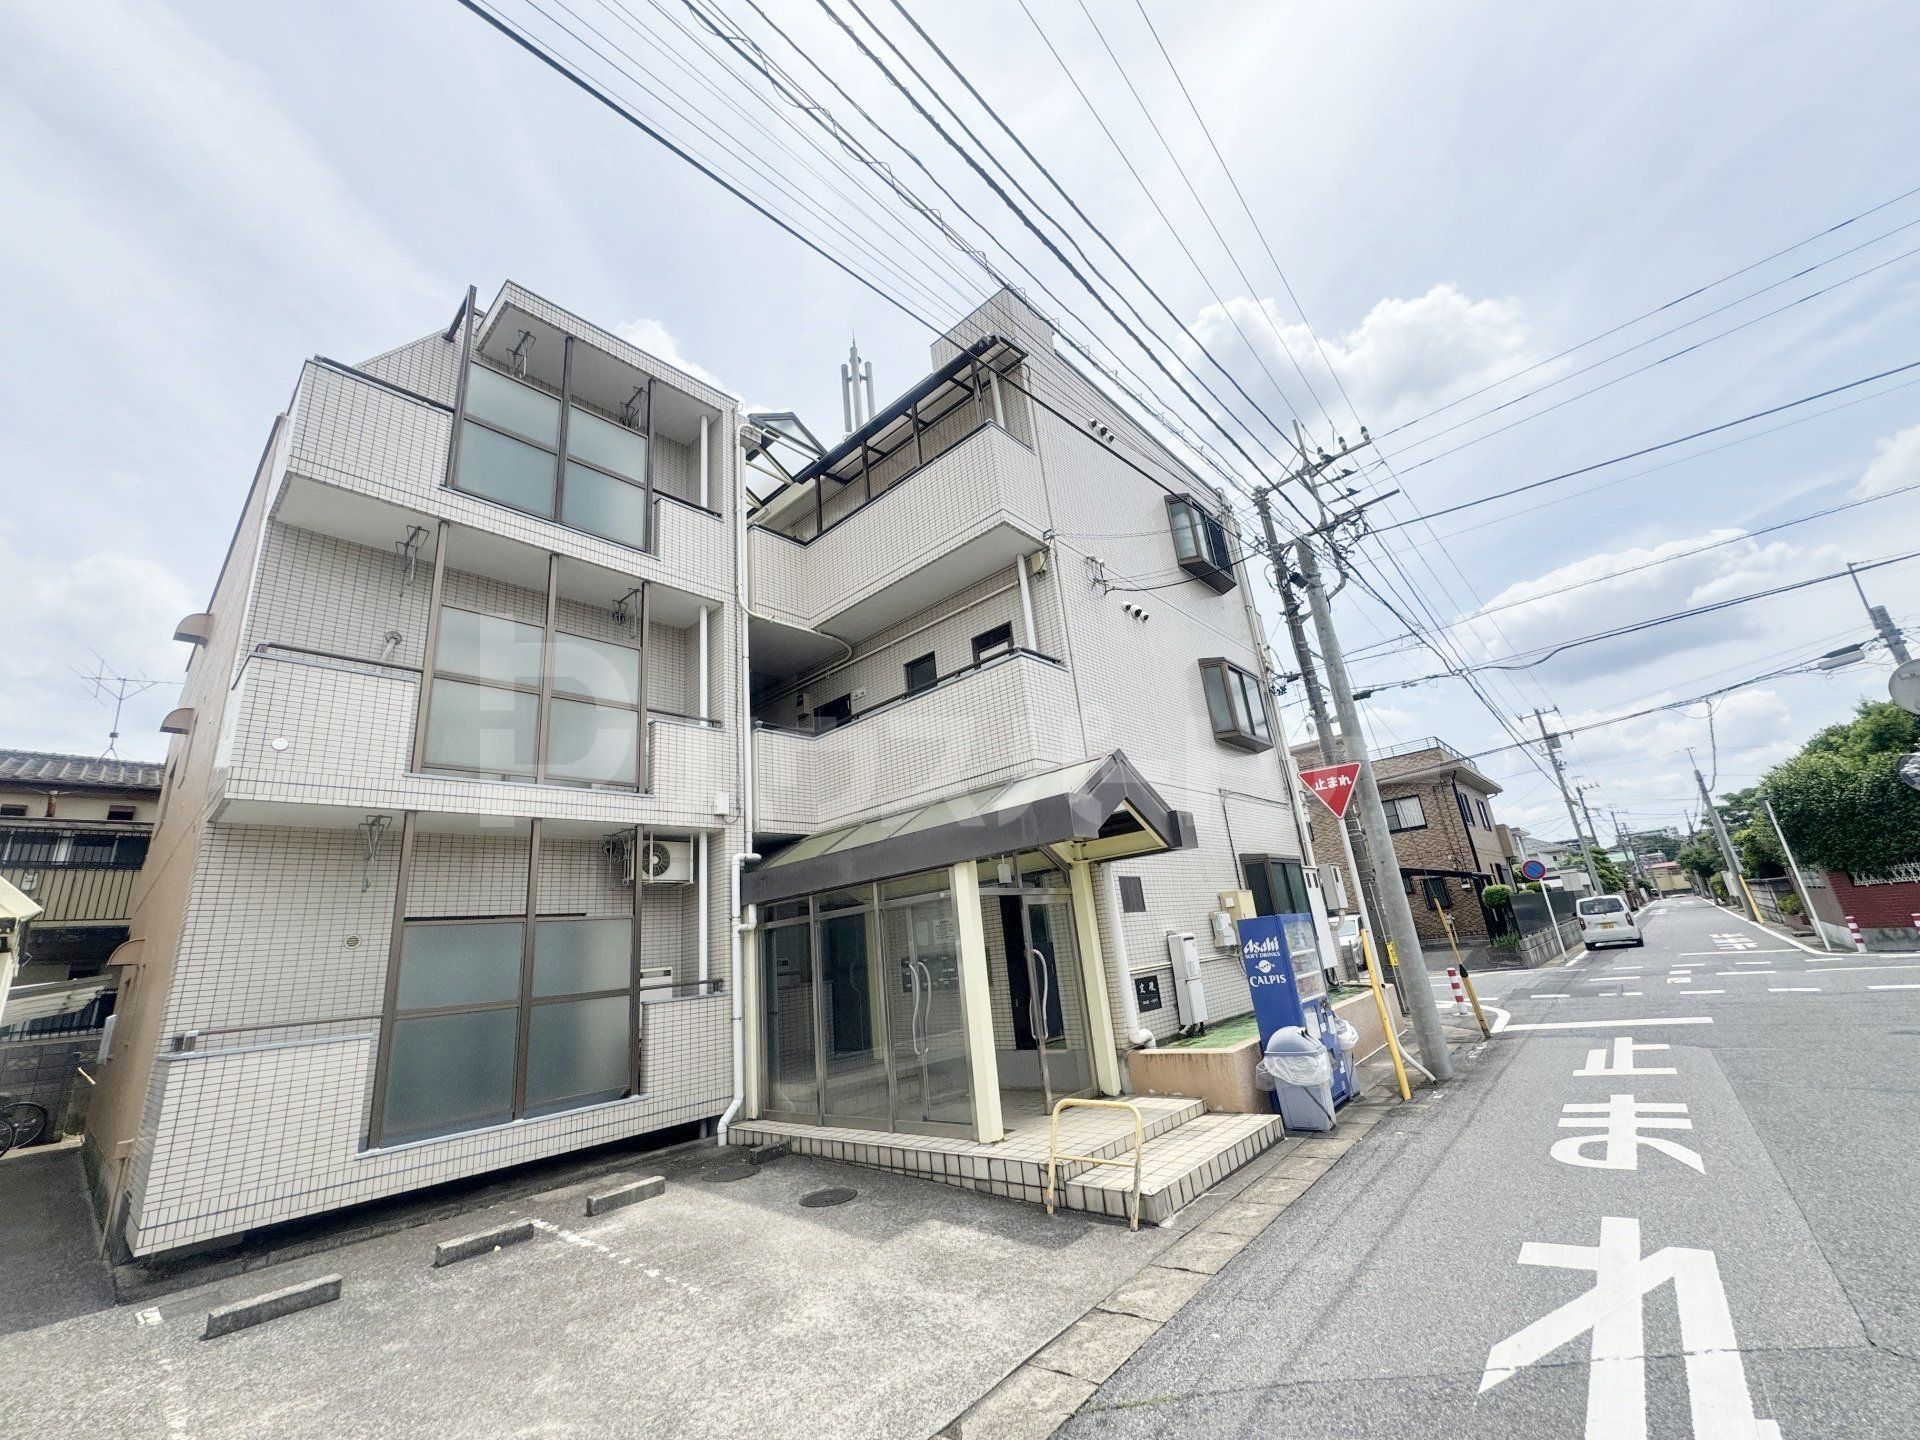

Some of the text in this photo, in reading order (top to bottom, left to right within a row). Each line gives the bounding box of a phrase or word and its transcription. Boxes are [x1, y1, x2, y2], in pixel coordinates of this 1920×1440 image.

[1315, 775, 1352, 790] 止まれ
[1244, 936, 1279, 953] Asahi
[1250, 974, 1286, 987] CALPIS
